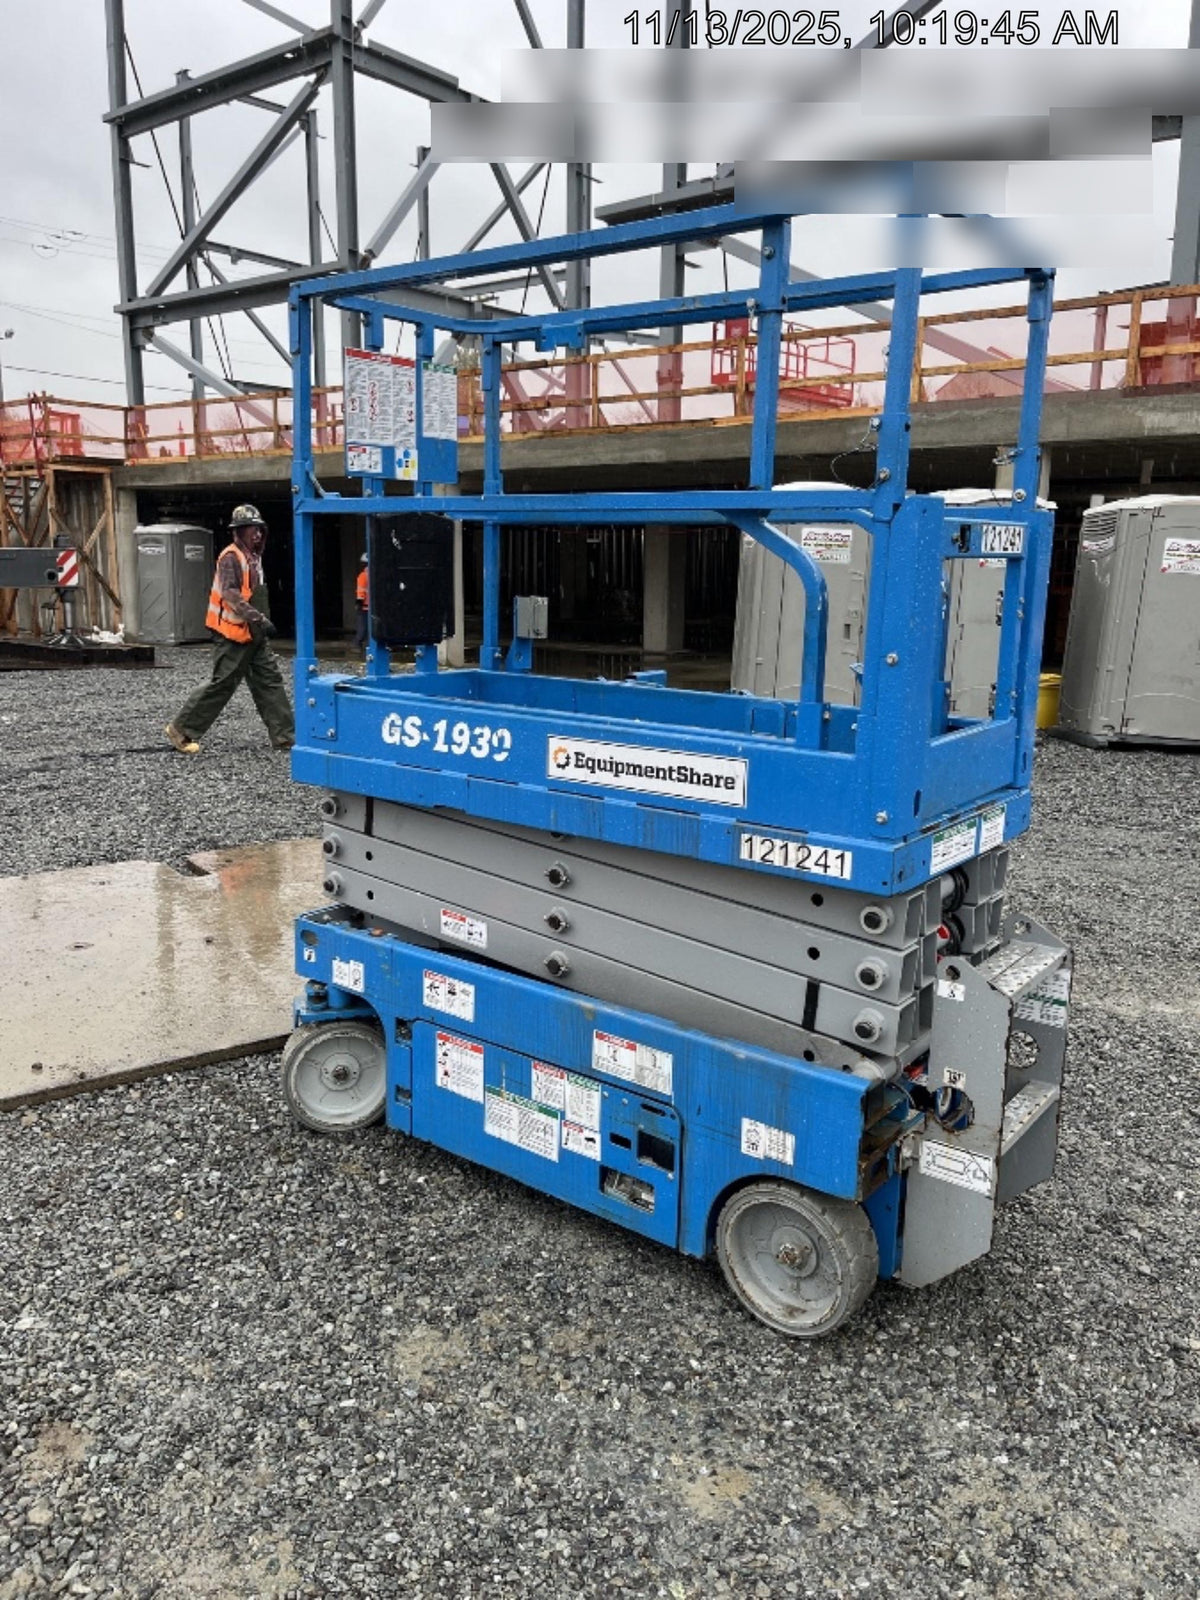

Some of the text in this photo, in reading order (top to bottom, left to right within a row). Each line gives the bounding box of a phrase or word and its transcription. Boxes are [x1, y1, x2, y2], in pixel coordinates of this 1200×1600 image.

[983, 524, 1022, 552] 121241
[573, 751, 736, 791] EquipmentShare
[743, 836, 846, 878] 121241
